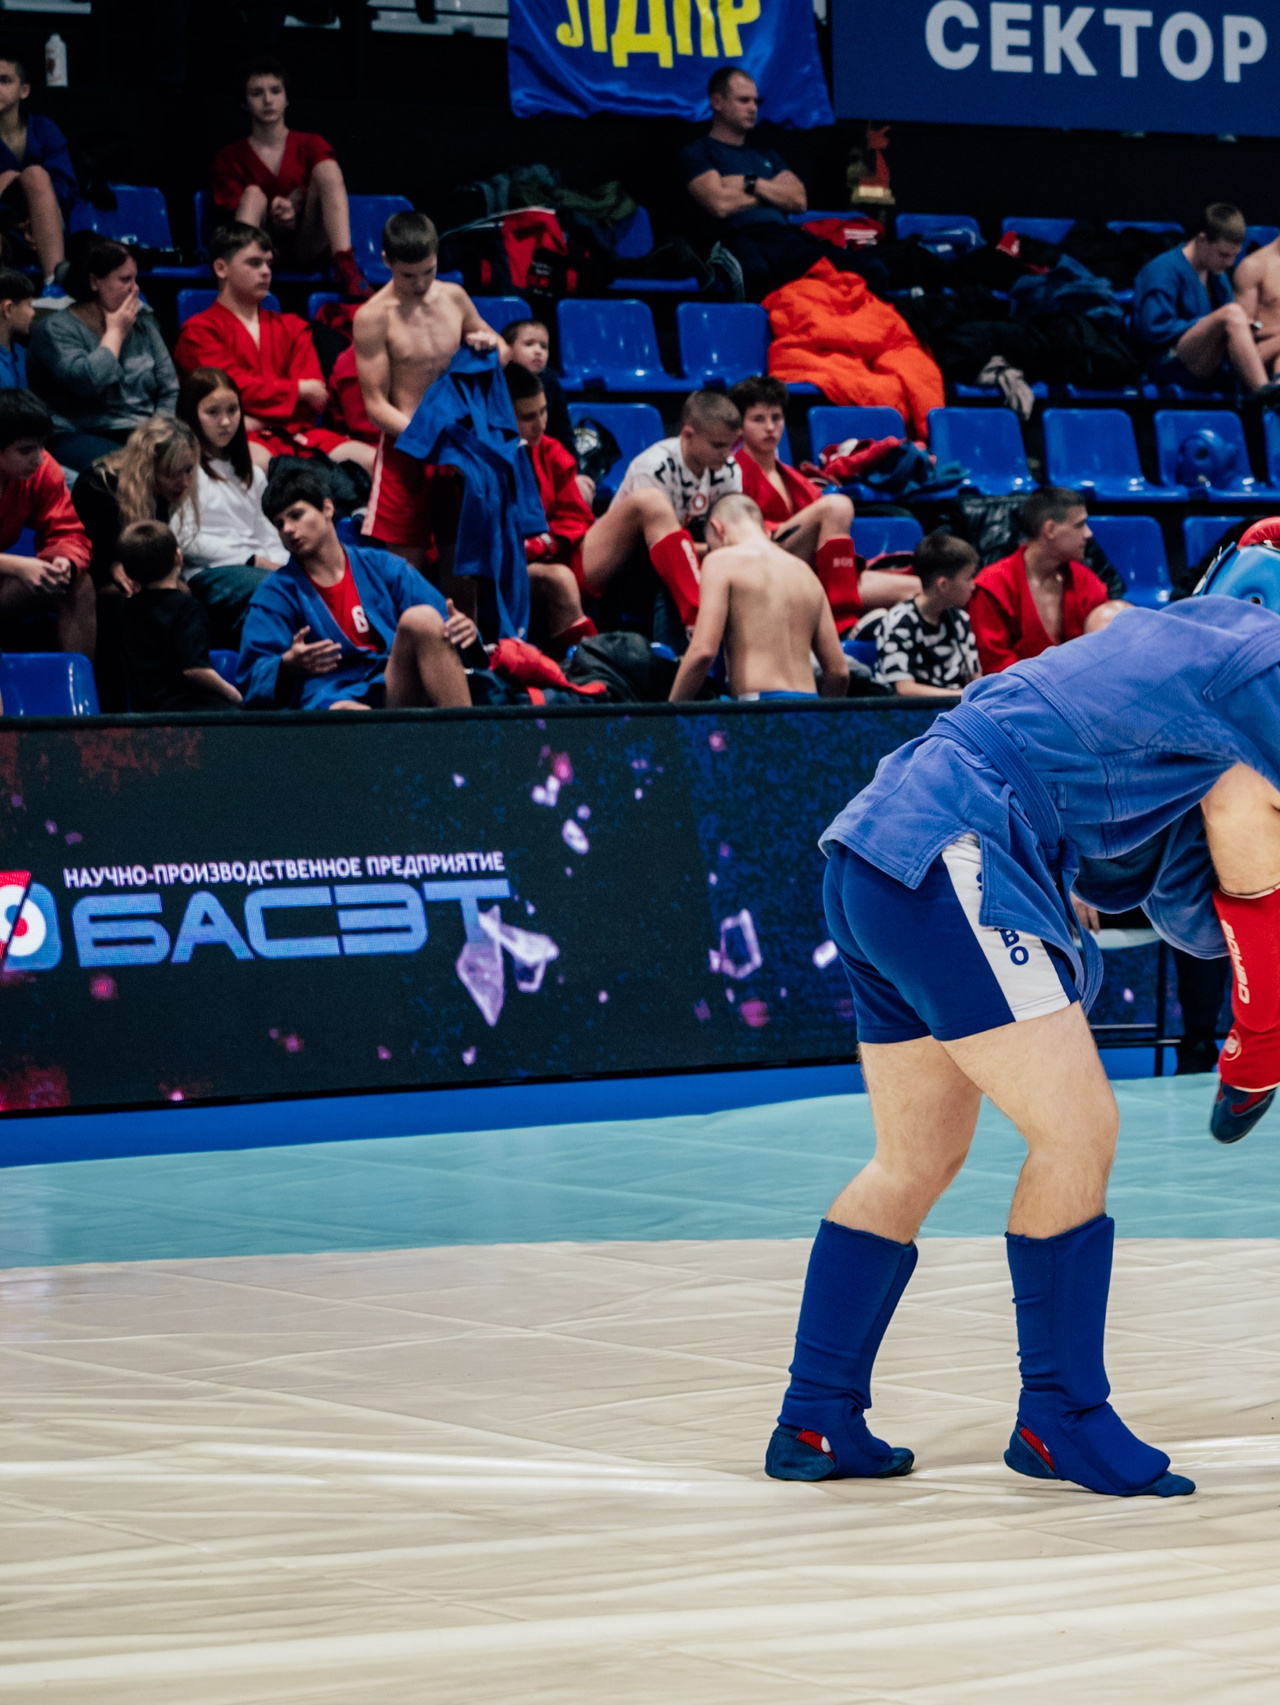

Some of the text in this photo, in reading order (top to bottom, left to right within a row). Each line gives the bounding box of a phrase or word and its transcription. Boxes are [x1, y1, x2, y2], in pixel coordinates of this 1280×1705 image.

[556, 0, 761, 68] ЛДПР
[925, 0, 1268, 83] СЕКТОР
[63, 851, 506, 887] НАУЧНО-ПРОИЗВОДСТВЕННОЕ ПРЕДПРИЯТИЕ
[71, 878, 512, 967] БАСЭТ
